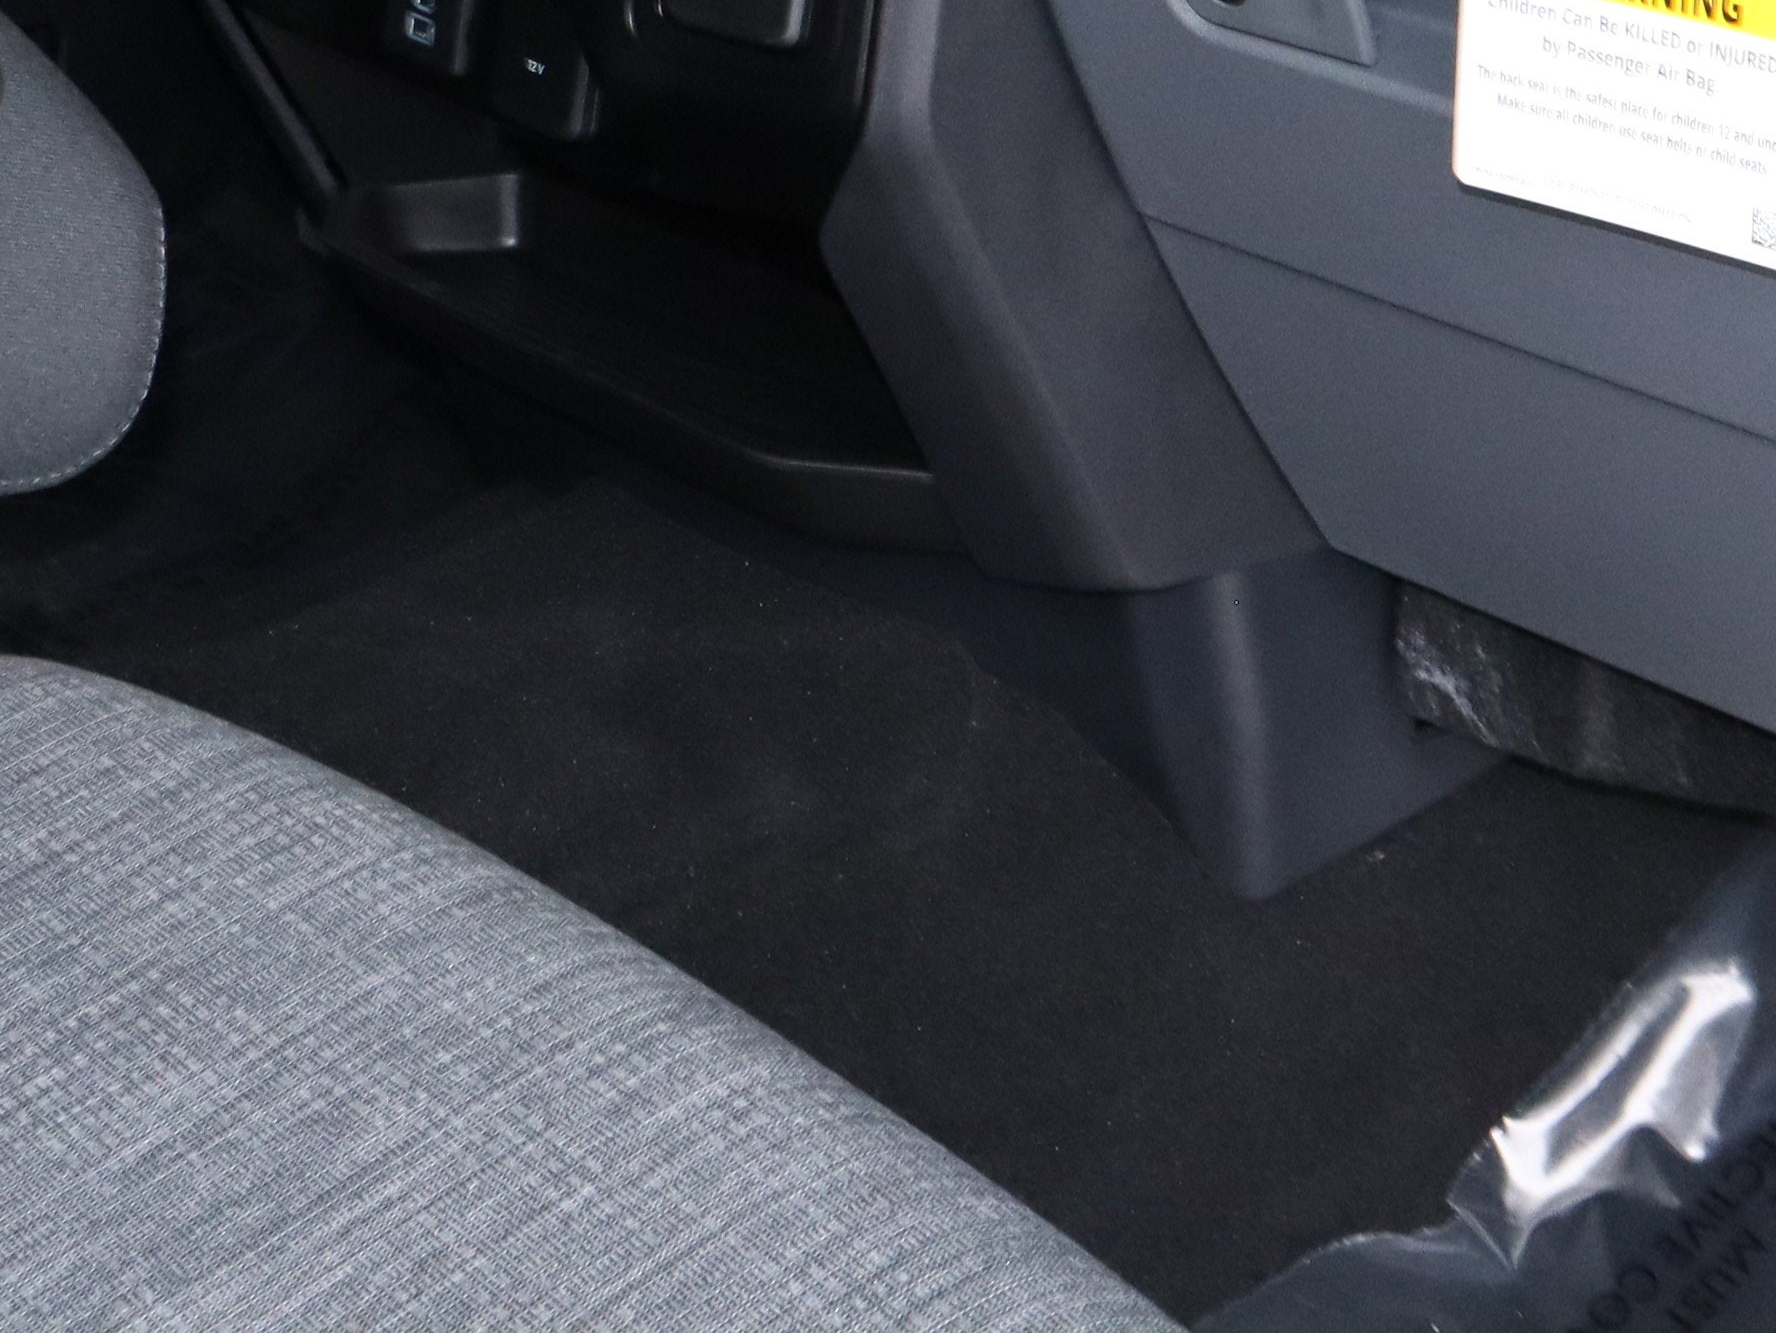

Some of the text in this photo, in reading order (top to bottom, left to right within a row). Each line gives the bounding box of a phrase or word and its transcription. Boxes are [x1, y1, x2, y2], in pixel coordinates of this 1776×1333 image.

[1542, 35, 1562, 57] by
[1567, 40, 1652, 77] Passenger
[1658, 63, 1679, 82] Air
[1562, 8, 1593, 30] Can
[1599, 15, 1619, 35] Be
[1625, 20, 1681, 50] KILLED
[1686, 40, 1705, 54] or
[1478, 64, 1497, 81] The
[1500, 70, 1524, 87] back
[1528, 79, 1549, 94] seat
[1565, 86, 1583, 101] the
[1586, 93, 1618, 111] safest
[1621, 101, 1648, 120] place
[1653, 106, 1667, 123] for
[1672, 113, 1714, 135] children
[1734, 128, 1754, 146] and
[1497, 93, 1526, 112] Make
[1530, 103, 1553, 120] sure
[1556, 109, 1569, 123] all
[1572, 113, 1616, 133] children
[1619, 126, 1637, 141] use
[1640, 131, 1663, 147] seat
[1667, 136, 1692, 155] belts
[1710, 148, 1736, 166] child
